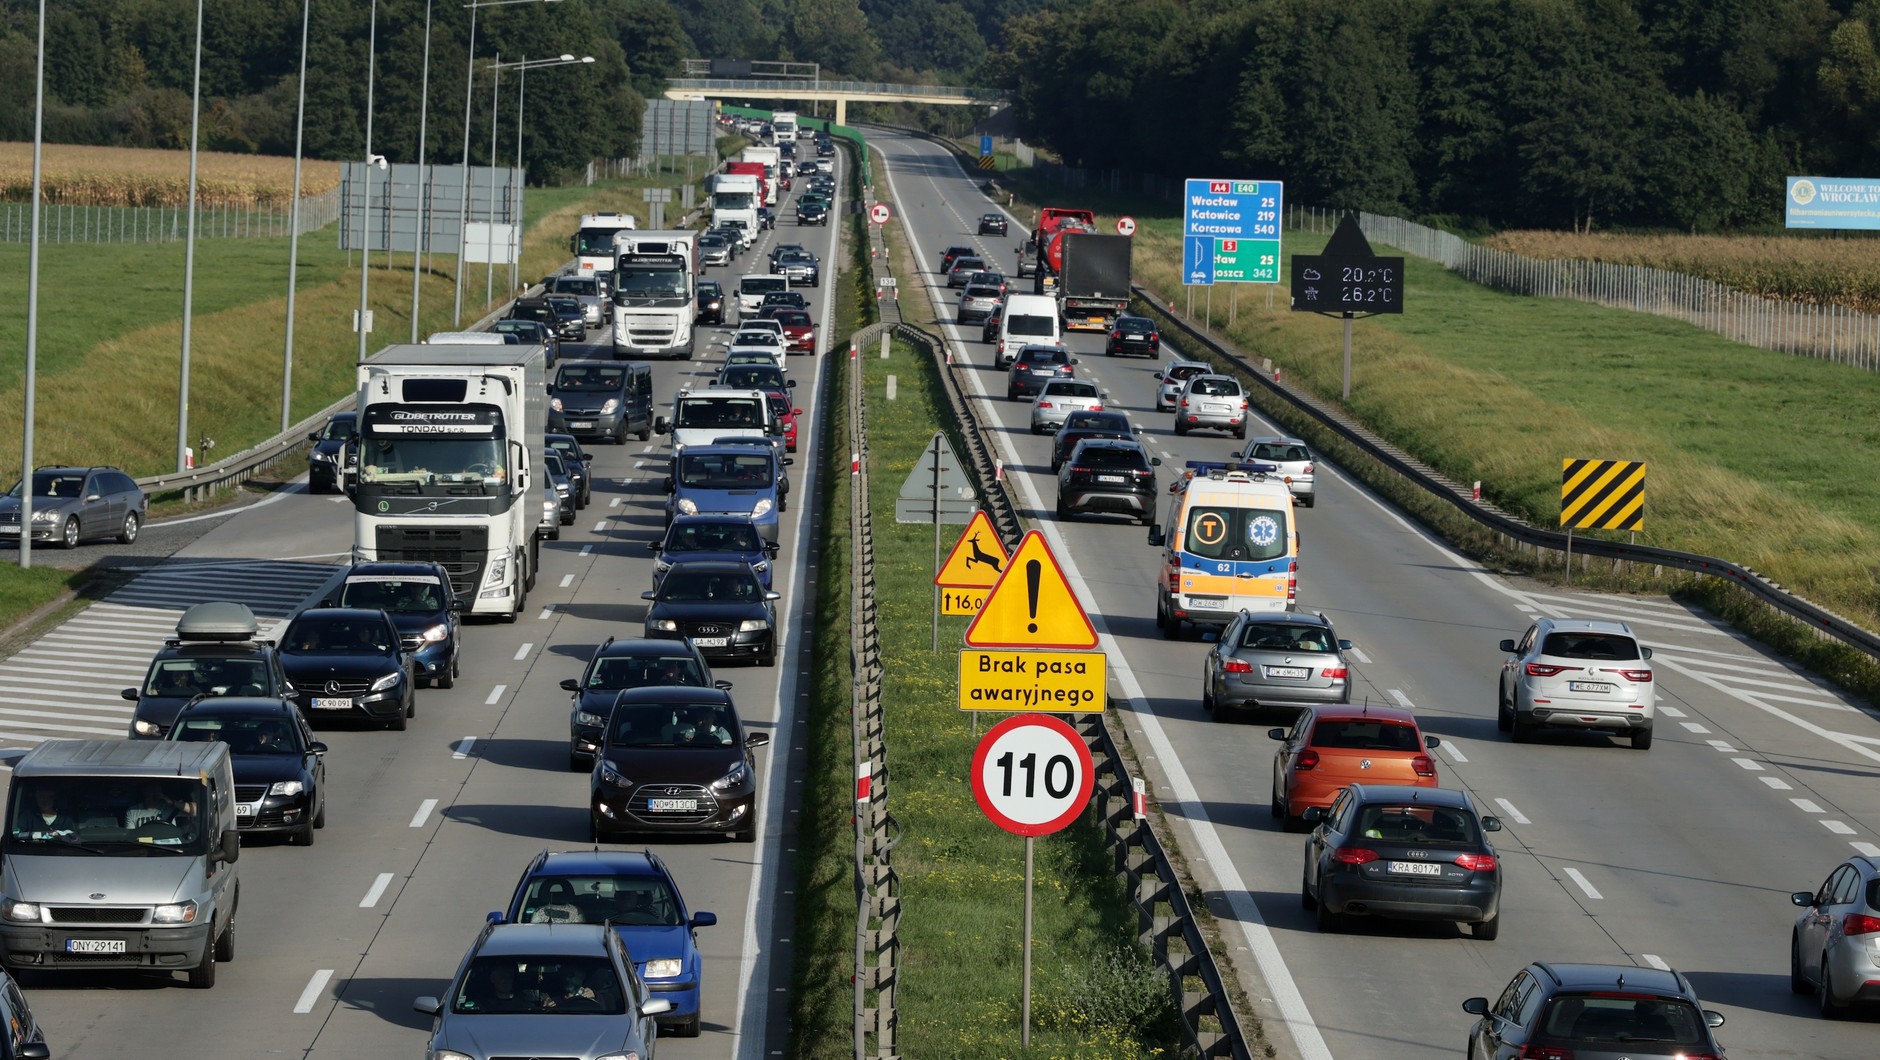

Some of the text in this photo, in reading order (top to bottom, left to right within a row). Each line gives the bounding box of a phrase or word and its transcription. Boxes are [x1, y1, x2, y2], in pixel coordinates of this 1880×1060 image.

[1214, 183, 1254, 193] A4 E40
[1820, 184, 1866, 193] WELCOME
[1191, 195, 1275, 208] Wrocław 25
[1820, 192, 1879, 203] WROCŁAW
[1191, 209, 1276, 221] Katowice 219
[1191, 222, 1275, 235] Korczowa 540
[1227, 242, 1233, 250] 5
[1260, 255, 1274, 265] 25
[1253, 268, 1273, 279] 342
[394, 412, 476, 421] GLOBETROTTER
[400, 425, 446, 433] TONDAU
[1203, 521, 1217, 538] T
[1217, 563, 1231, 572] 62
[979, 655, 1087, 679] Brak pasa
[970, 683, 1095, 707] awaryjnego
[996, 751, 1075, 800] 110
[668, 801, 696, 809] 913CD
[1392, 862, 1440, 874] KRA 8017W
[72, 940, 124, 952] ONY 29141
